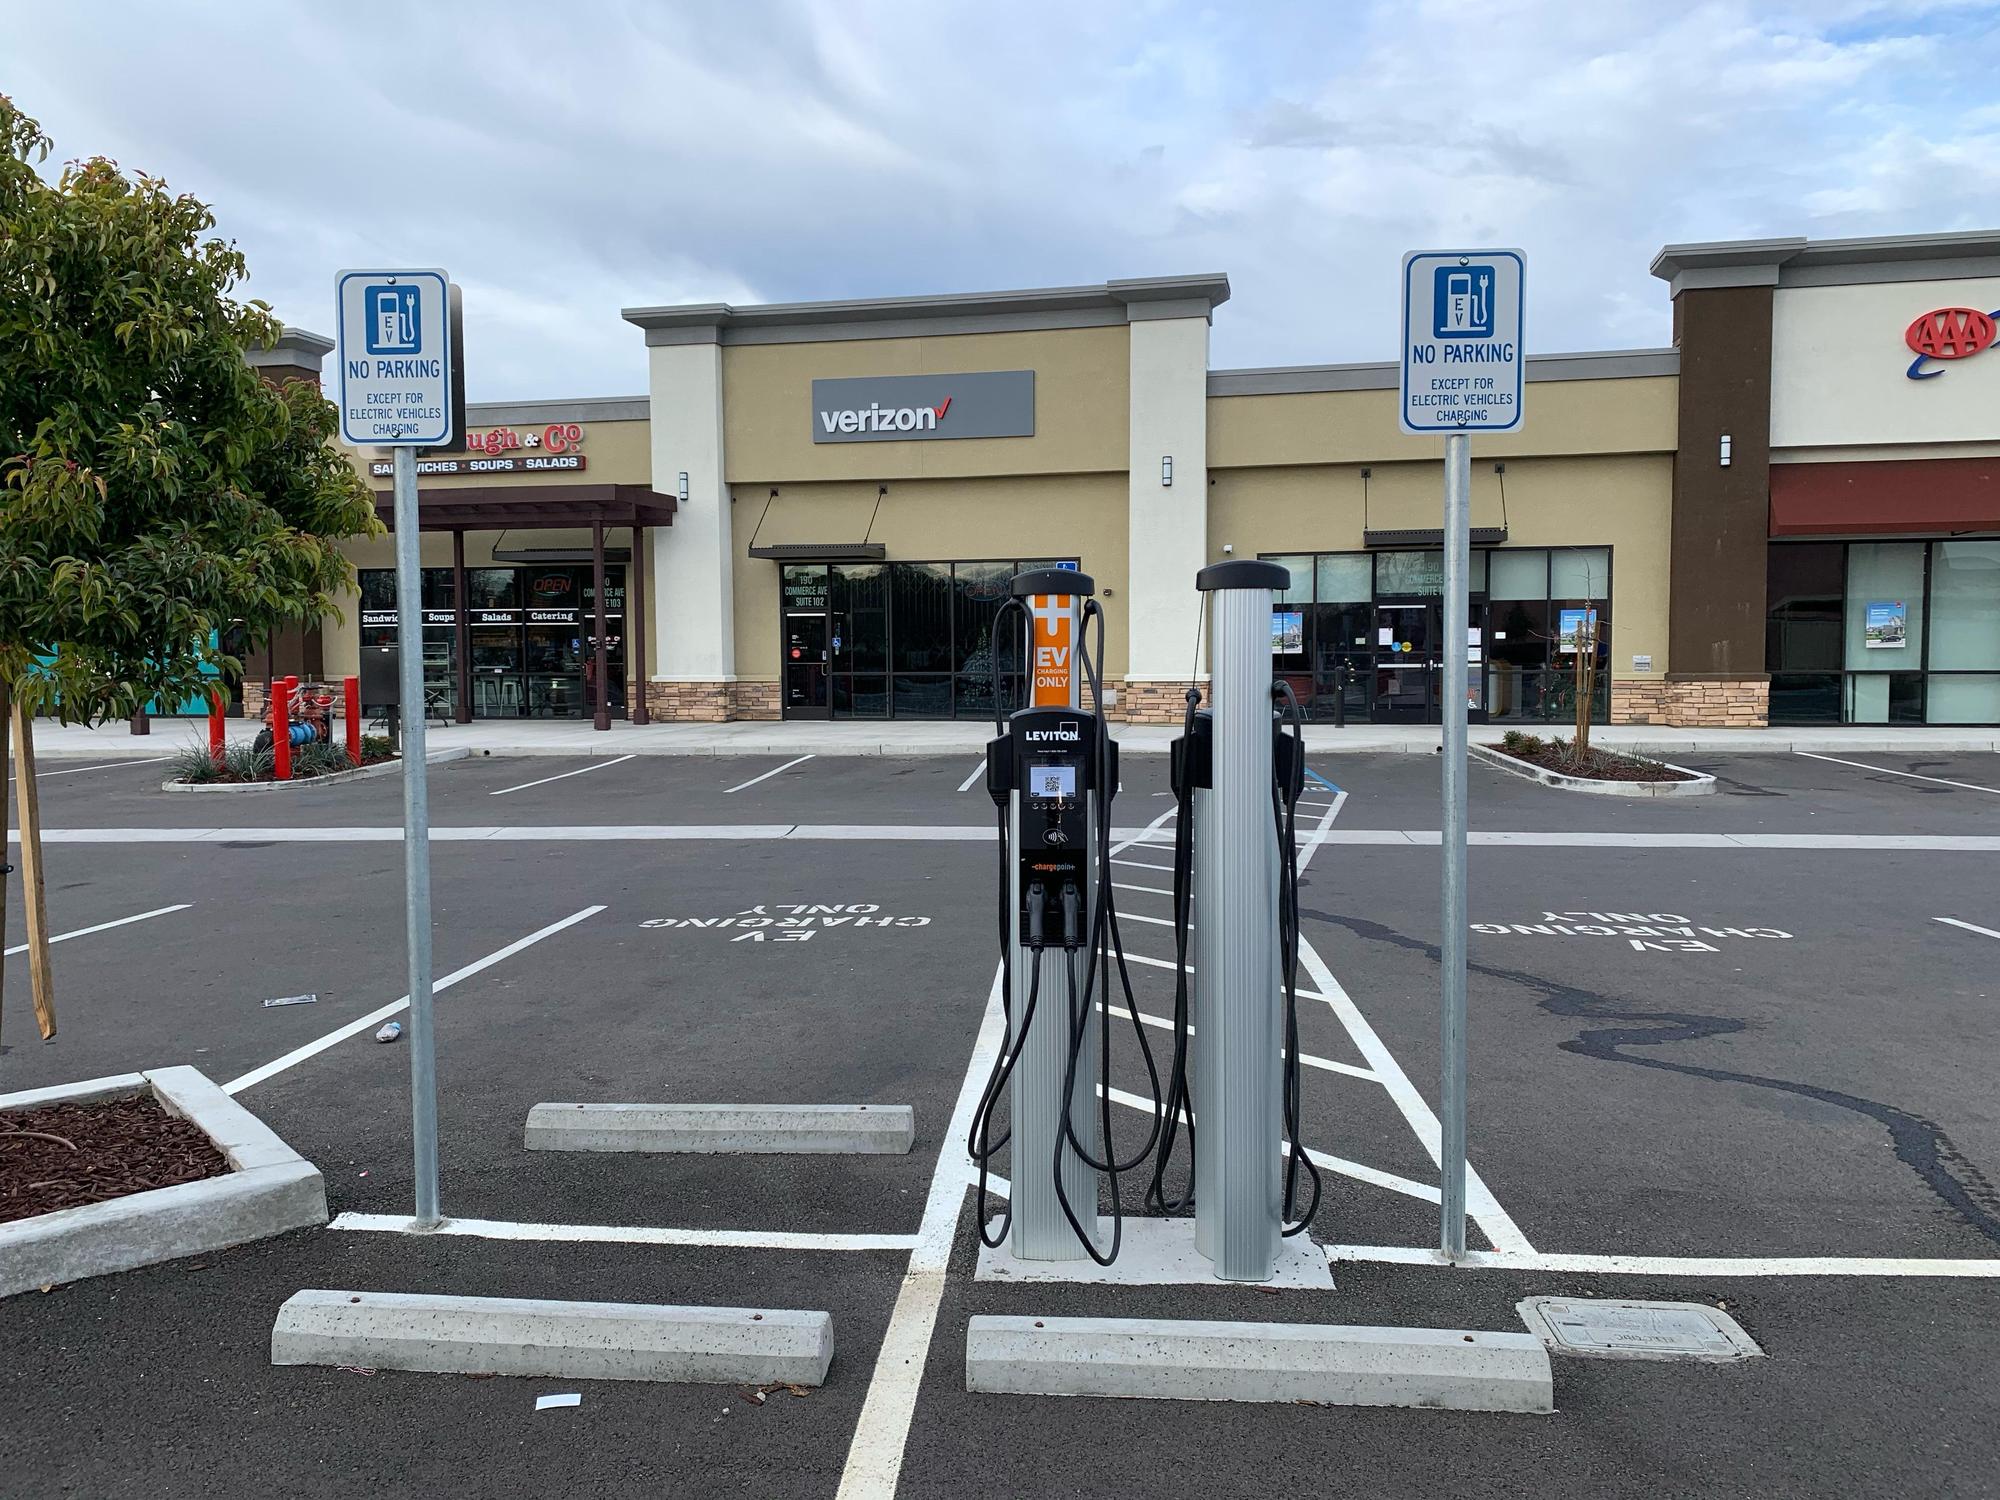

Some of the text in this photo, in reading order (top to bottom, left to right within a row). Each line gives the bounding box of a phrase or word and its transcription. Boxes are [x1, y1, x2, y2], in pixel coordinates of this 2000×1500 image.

[1917, 308, 1985, 356] AAA
[1413, 343, 1513, 363] NO PARKING
[349, 360, 440, 379] NO PARKING
[1431, 378, 1494, 390] EXCEPT FOR
[367, 393, 423, 404] EXCEPT FOR
[1412, 394, 1513, 406] ELECTRIC VEHICLES
[350, 407, 441, 419] ELECTRIC VEHICLES
[820, 402, 936, 433] verizon
[1436, 410, 1488, 422] CHARGING
[372, 423, 419, 435] CHARGING
[524, 433, 540, 447] &
[373, 457, 578, 474] SAICHES SOUPS SALADS
[533, 578, 571, 592] OPEN
[785, 585, 828, 596] COMMERCE AVE
[614, 587, 625, 597] AVE
[610, 598, 621, 608] 103
[796, 597, 824, 606] SUITE 102
[362, 614, 398, 623] Sandwic
[428, 613, 455, 623] Soups
[482, 613, 512, 622] Salads
[531, 612, 573, 622] Catering
[1037, 646, 1068, 667] EV
[1036, 677, 1068, 688] ONLY
[736, 904, 881, 915] ONLY
[638, 916, 932, 928] CHARGING
[1542, 911, 1692, 924] ONLY
[729, 930, 817, 942] EV
[1469, 924, 1794, 939] CHARGING
[1628, 939, 1721, 952] EV
